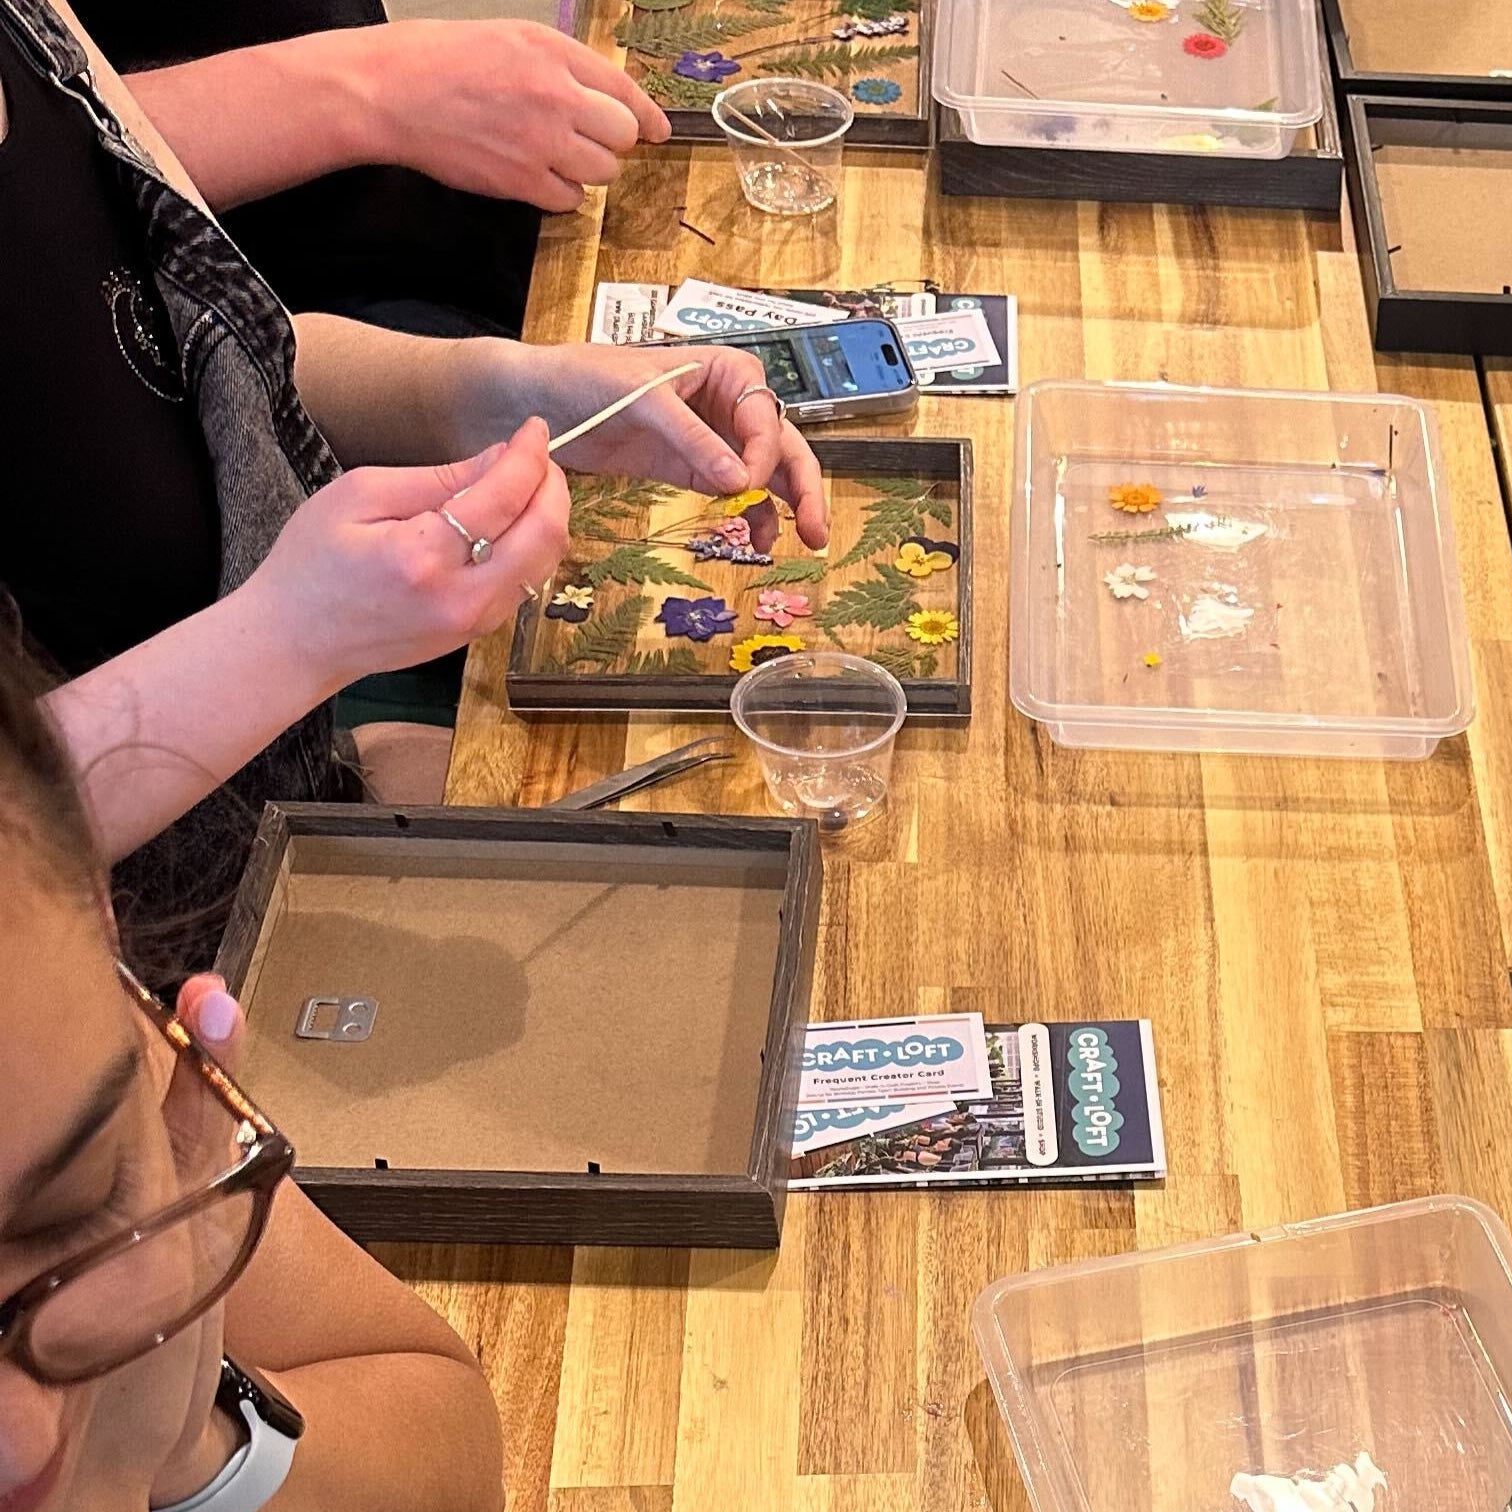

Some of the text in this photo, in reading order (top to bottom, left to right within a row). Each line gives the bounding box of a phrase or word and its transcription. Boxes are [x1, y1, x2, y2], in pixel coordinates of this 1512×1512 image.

[802, 1041, 951, 1067] CRAFT LOFT
[813, 1069, 945, 1085] Frequent Creator Card
[1077, 1033, 1113, 1147] CRAFT LOFT
